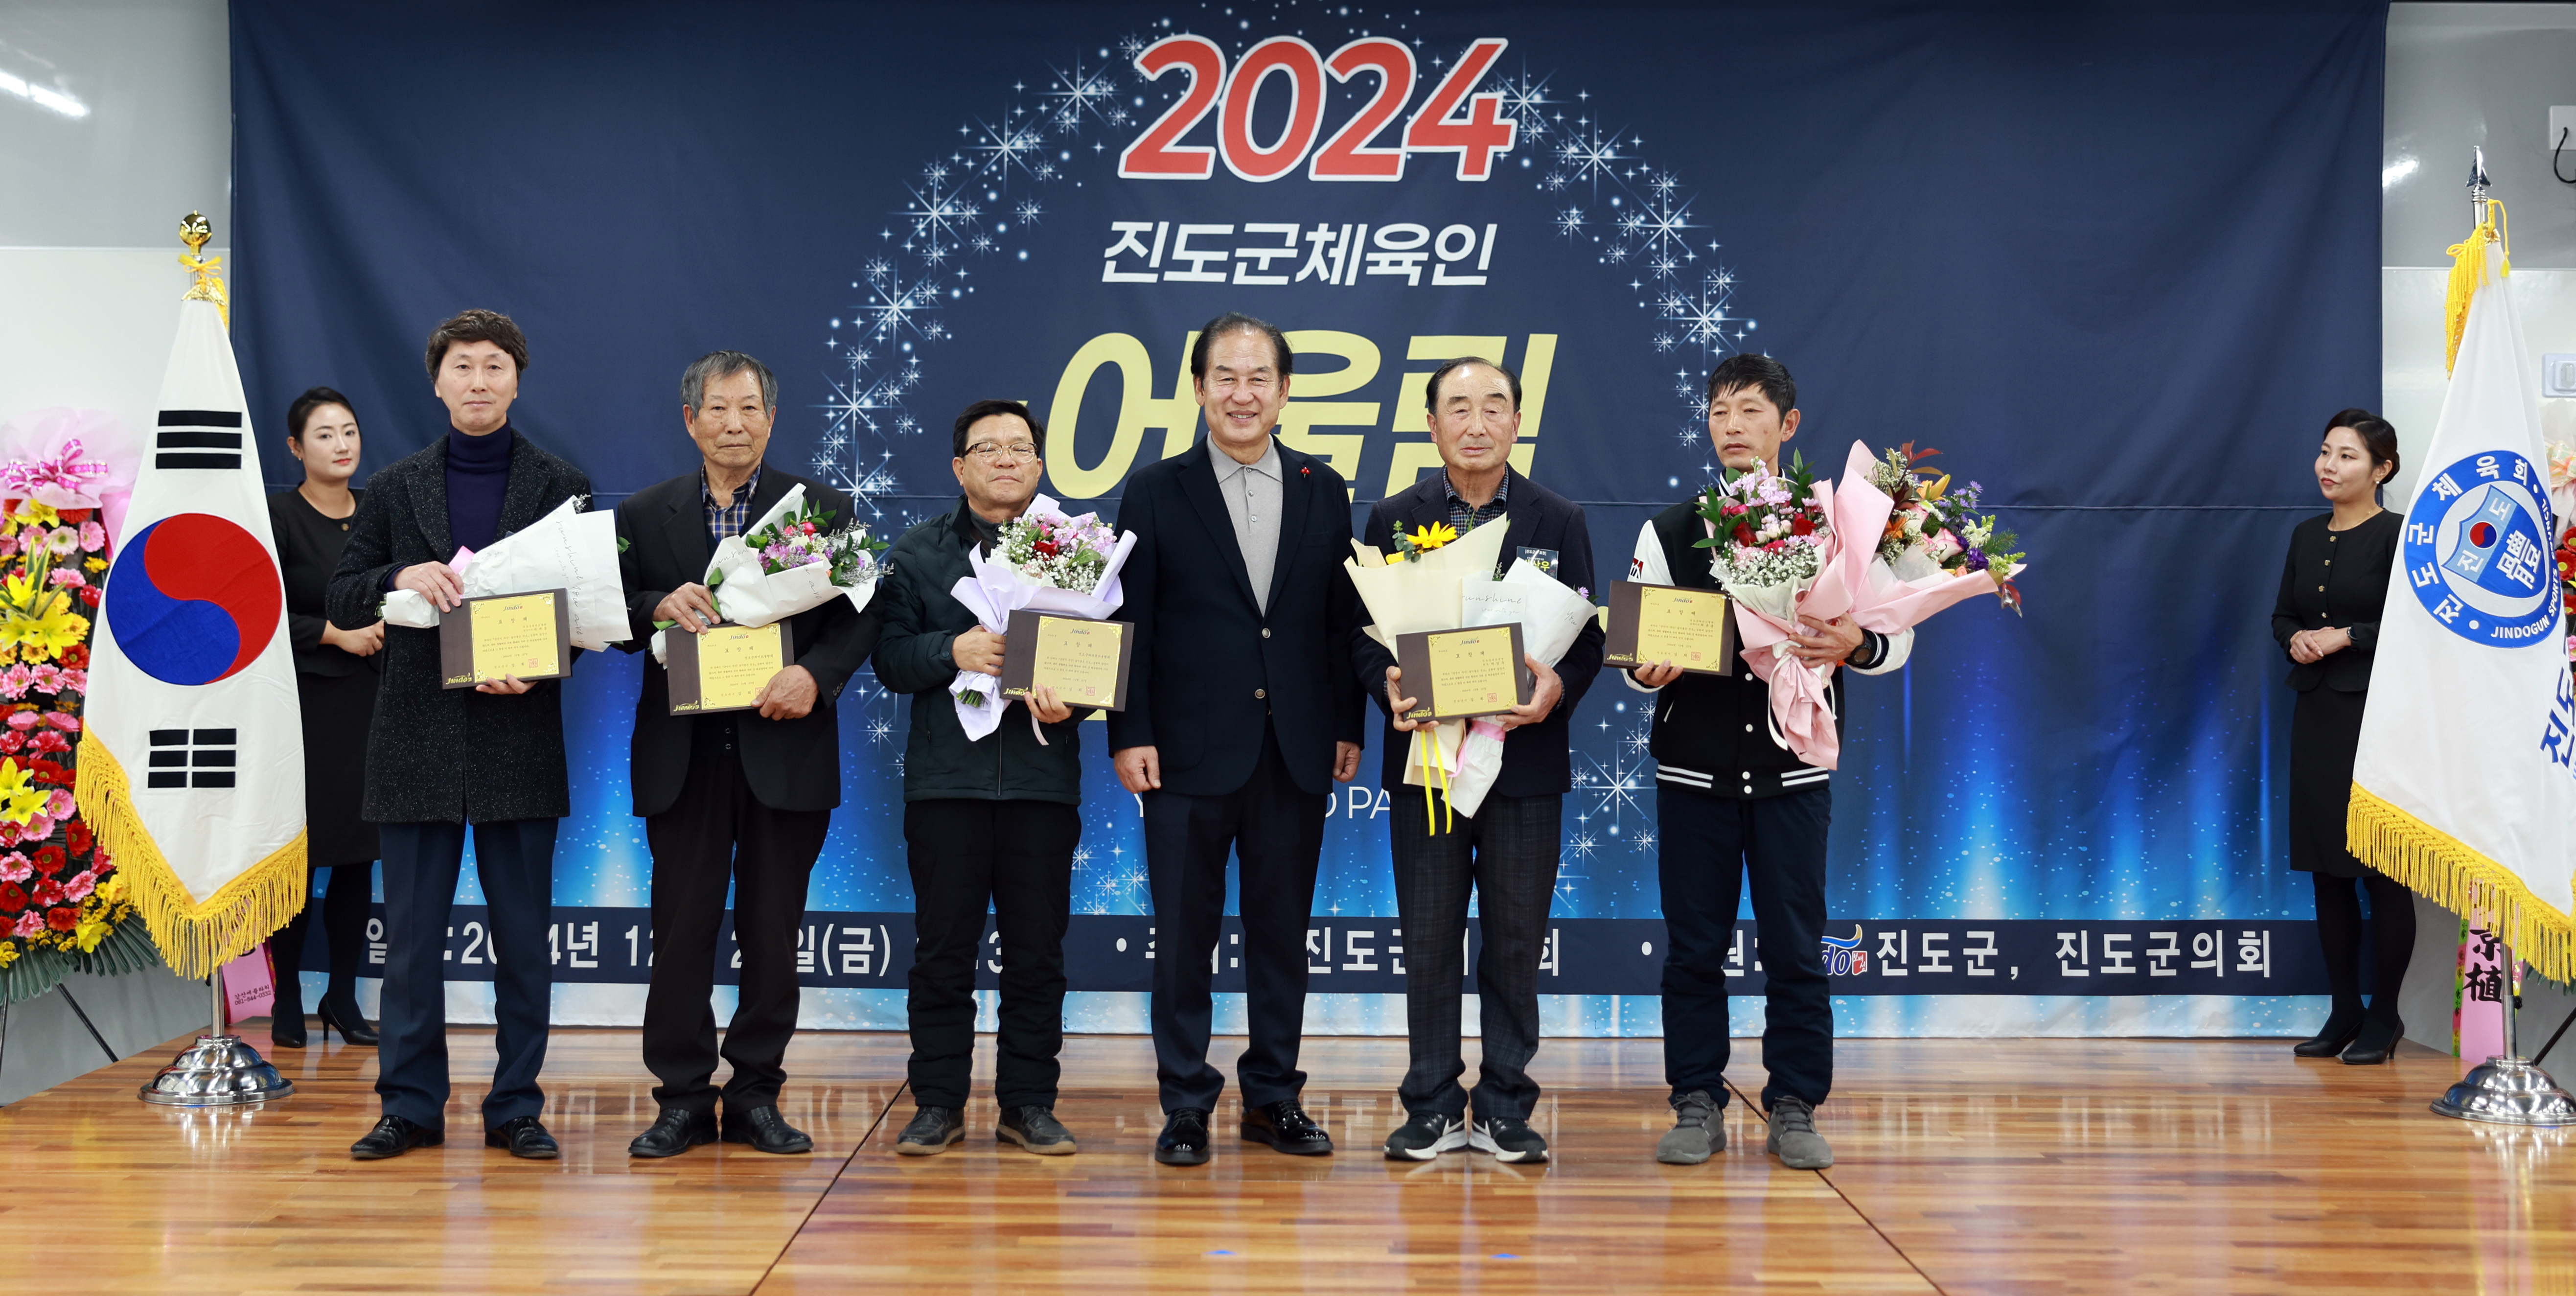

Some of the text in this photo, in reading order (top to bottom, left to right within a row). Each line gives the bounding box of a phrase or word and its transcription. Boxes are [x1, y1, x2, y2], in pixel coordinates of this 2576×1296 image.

[1118, 35, 1517, 182] 2024
[1102, 222, 1497, 286] 진도군체육인
[1462, 593, 1521, 604] unshine
[2491, 615, 2550, 639] JINDOGUN
[2548, 568, 2558, 617] SPORTS
[1876, 929, 2270, 979] 진도군, 진도군의회
